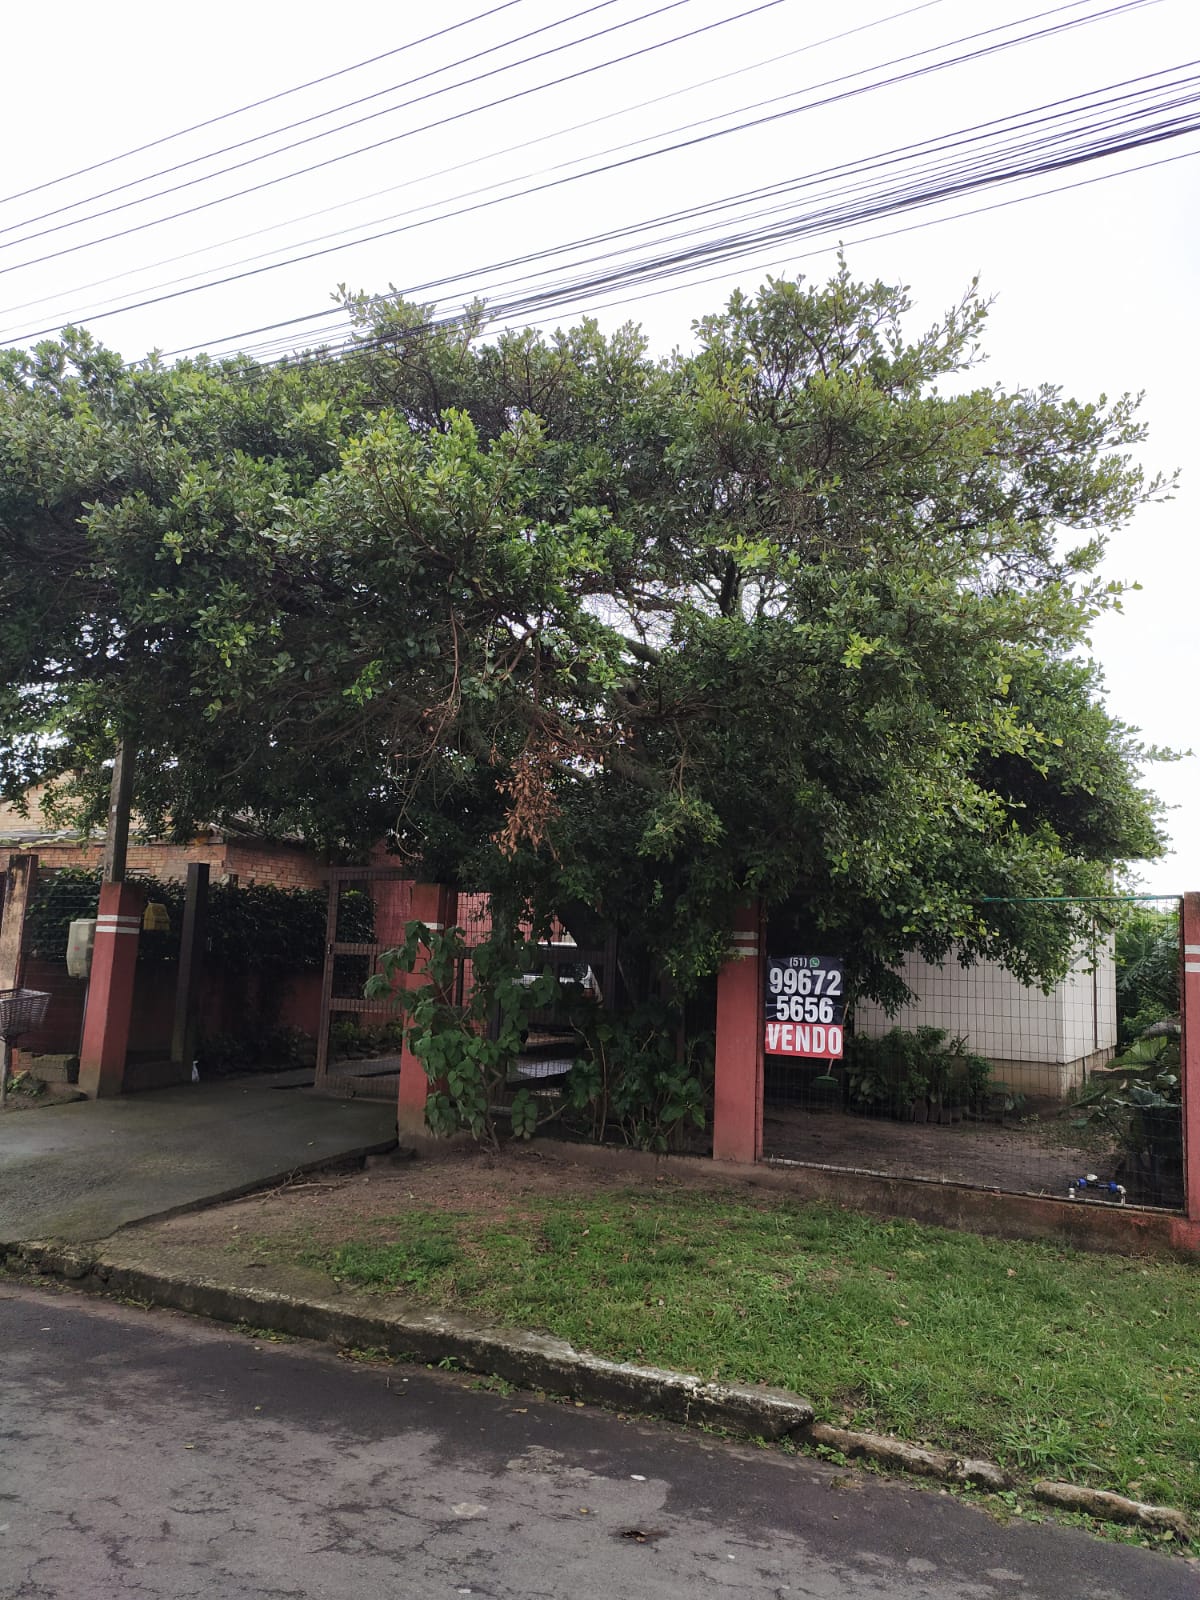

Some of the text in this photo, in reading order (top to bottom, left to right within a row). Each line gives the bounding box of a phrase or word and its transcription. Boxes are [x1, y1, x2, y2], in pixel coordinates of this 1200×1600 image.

[789, 957, 808, 967] (51)
[769, 967, 842, 996] 99672
[776, 995, 834, 1024] 5656
[767, 1023, 842, 1055] VENDO
